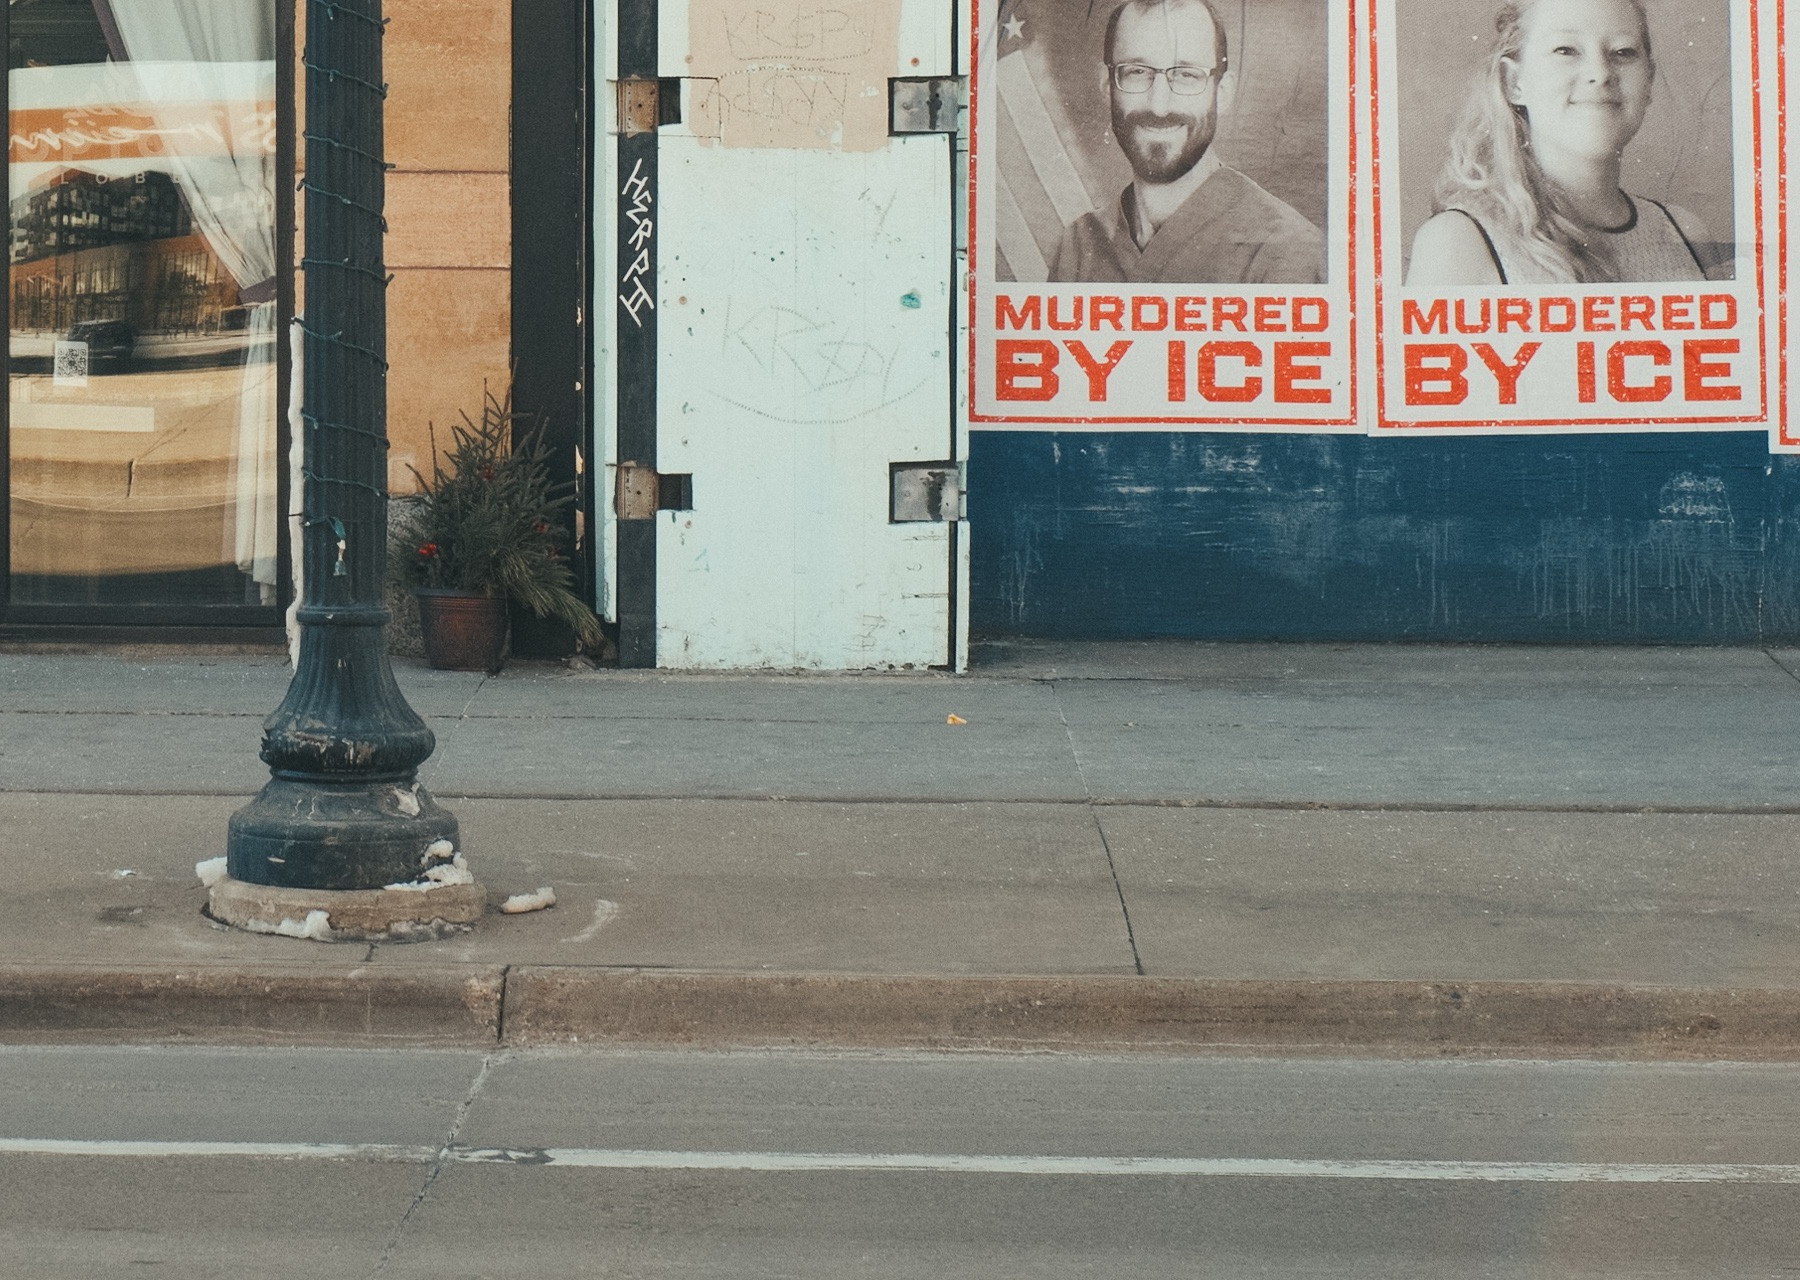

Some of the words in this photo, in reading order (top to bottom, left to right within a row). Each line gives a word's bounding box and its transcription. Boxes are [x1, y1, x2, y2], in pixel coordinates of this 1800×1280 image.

[995, 294, 1329, 333] MURDERED
[1403, 293, 1738, 336] MURDERED
[995, 339, 1134, 402] BY
[1167, 340, 1332, 404] ICE
[1403, 341, 1543, 407] BY
[1576, 338, 1742, 404] ICE
